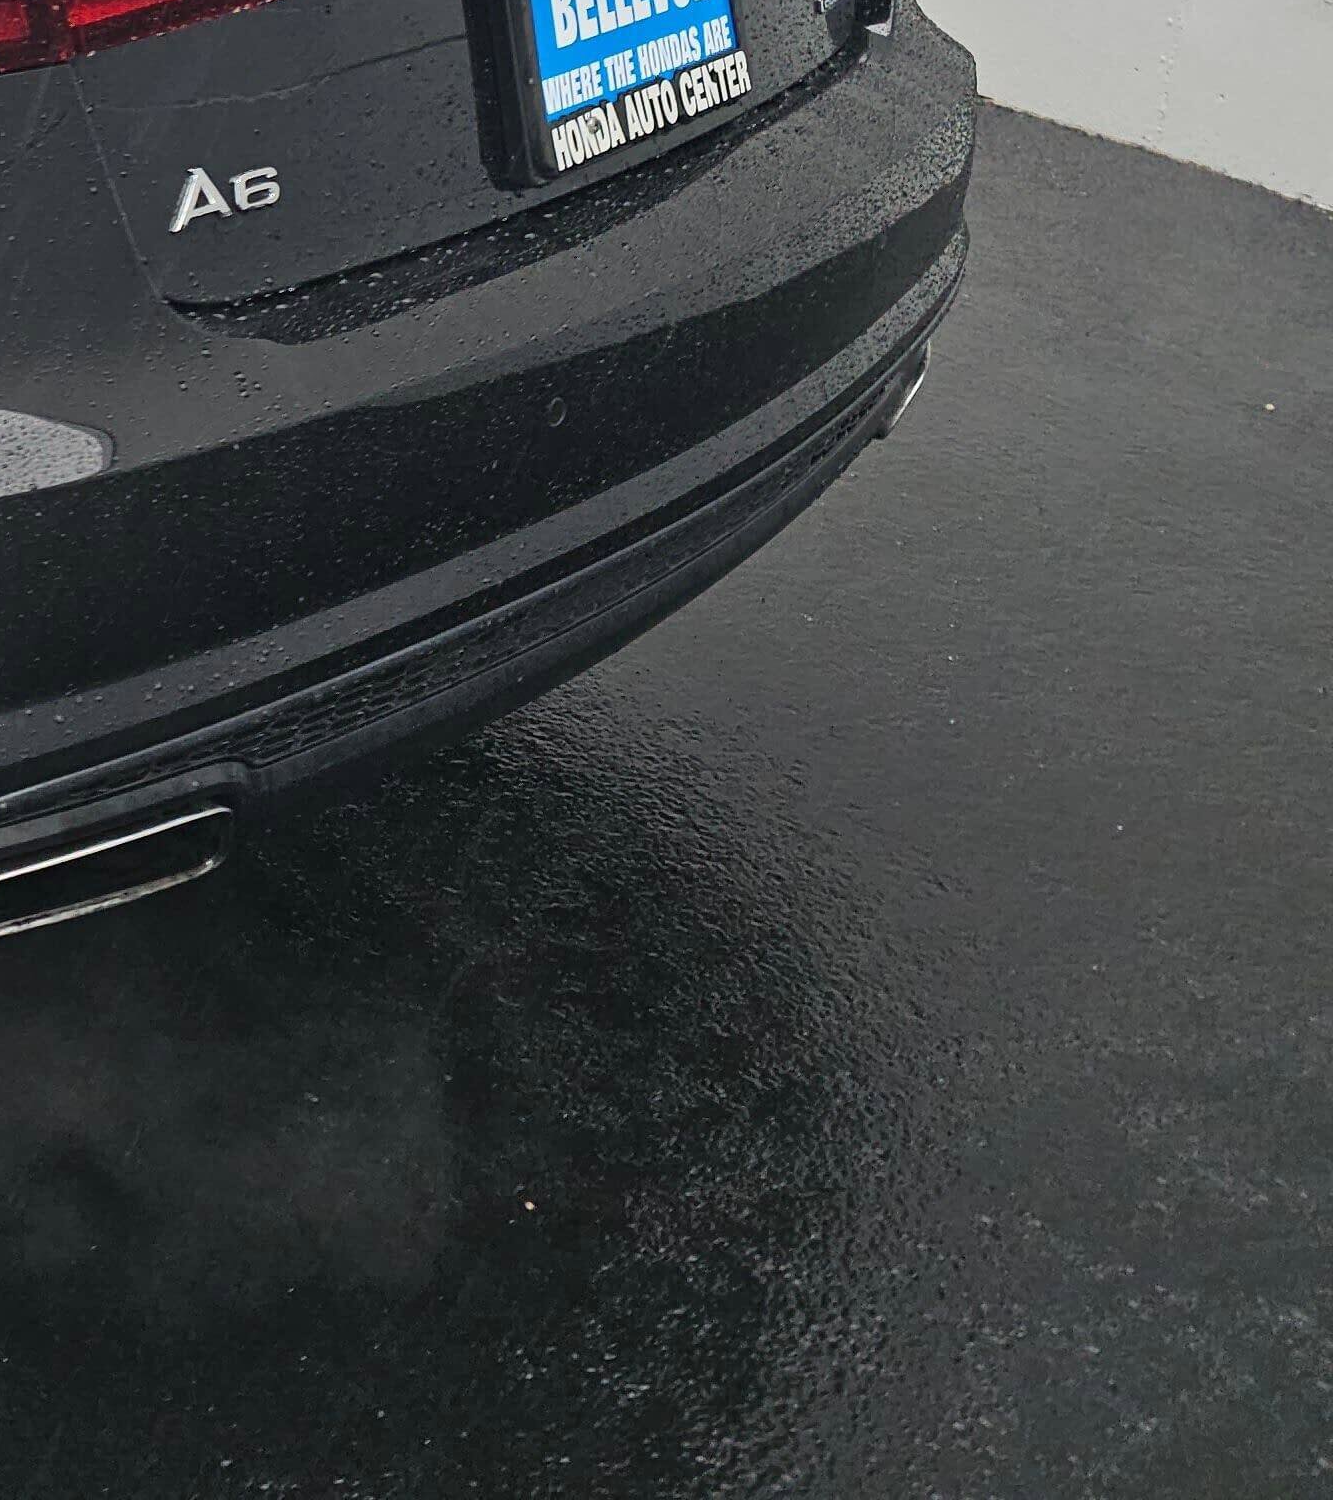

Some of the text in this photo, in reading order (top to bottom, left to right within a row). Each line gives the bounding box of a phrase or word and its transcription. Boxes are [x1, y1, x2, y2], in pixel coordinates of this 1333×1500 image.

[541, 14, 733, 115] WHERE THE HONDAS ARE
[551, 50, 752, 172] HONDA AUTO CENTER
[168, 166, 281, 233] A6
